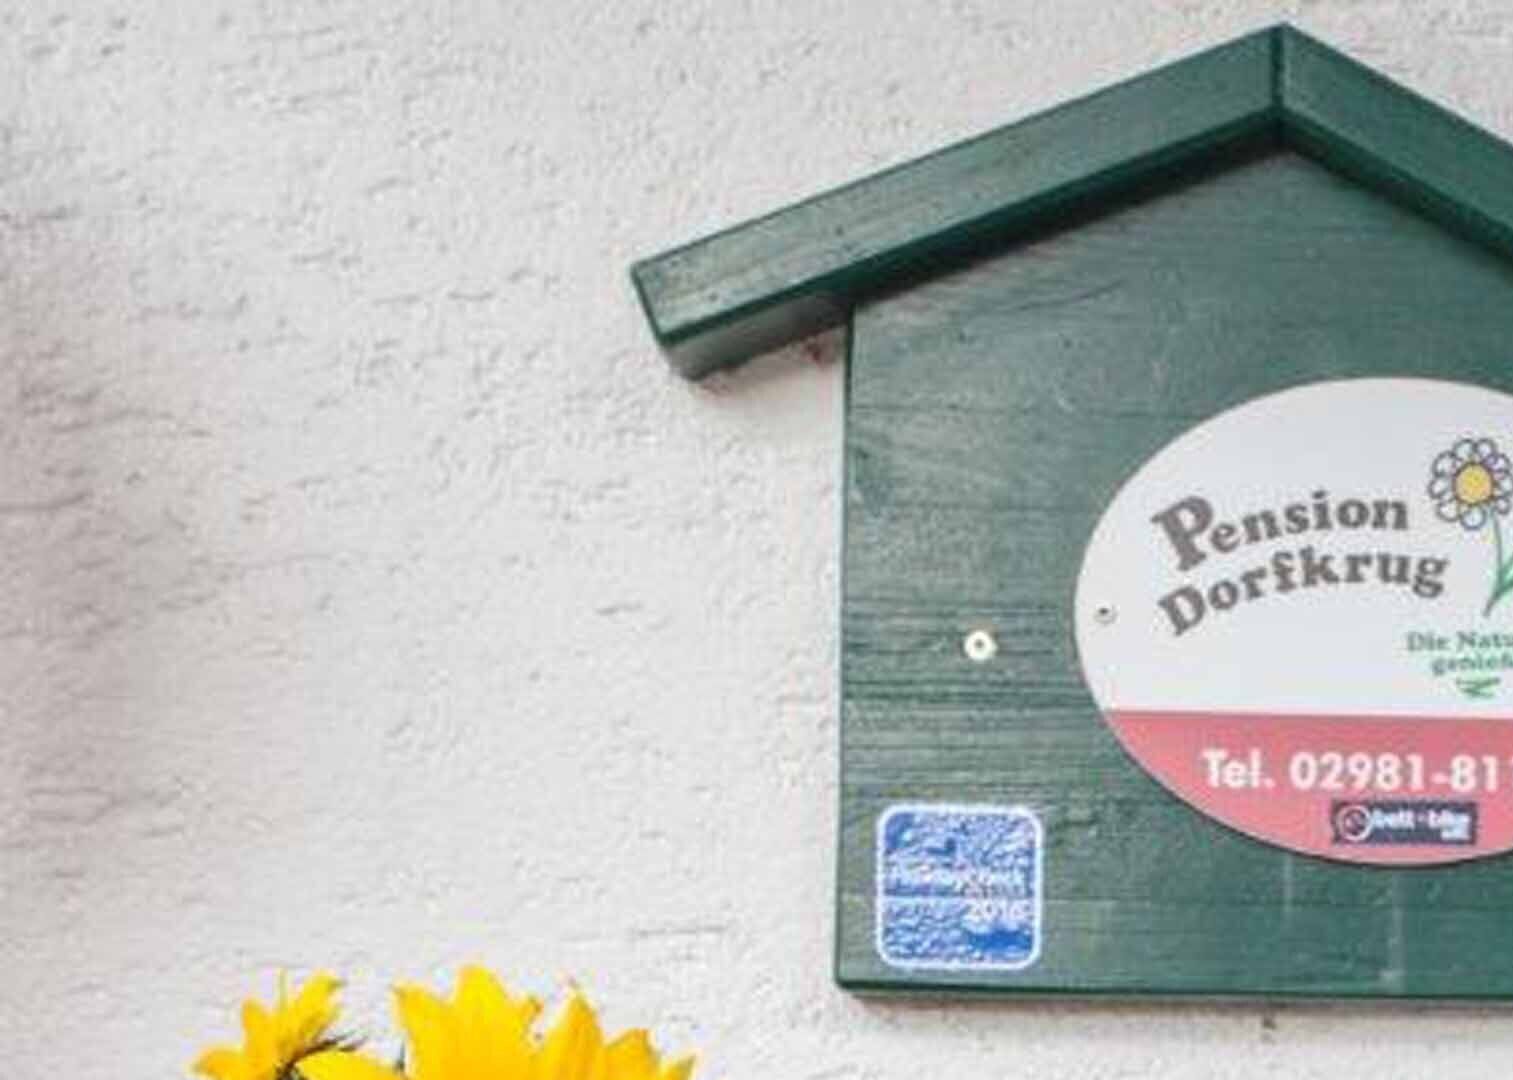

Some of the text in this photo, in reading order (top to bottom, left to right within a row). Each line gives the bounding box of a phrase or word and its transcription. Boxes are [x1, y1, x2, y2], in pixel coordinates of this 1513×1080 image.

[1152, 489, 1409, 572] Pension
[1158, 548, 1448, 636] Dorfkrug
[1405, 631, 1449, 651] Die
[1202, 750, 1274, 792] Tel.
